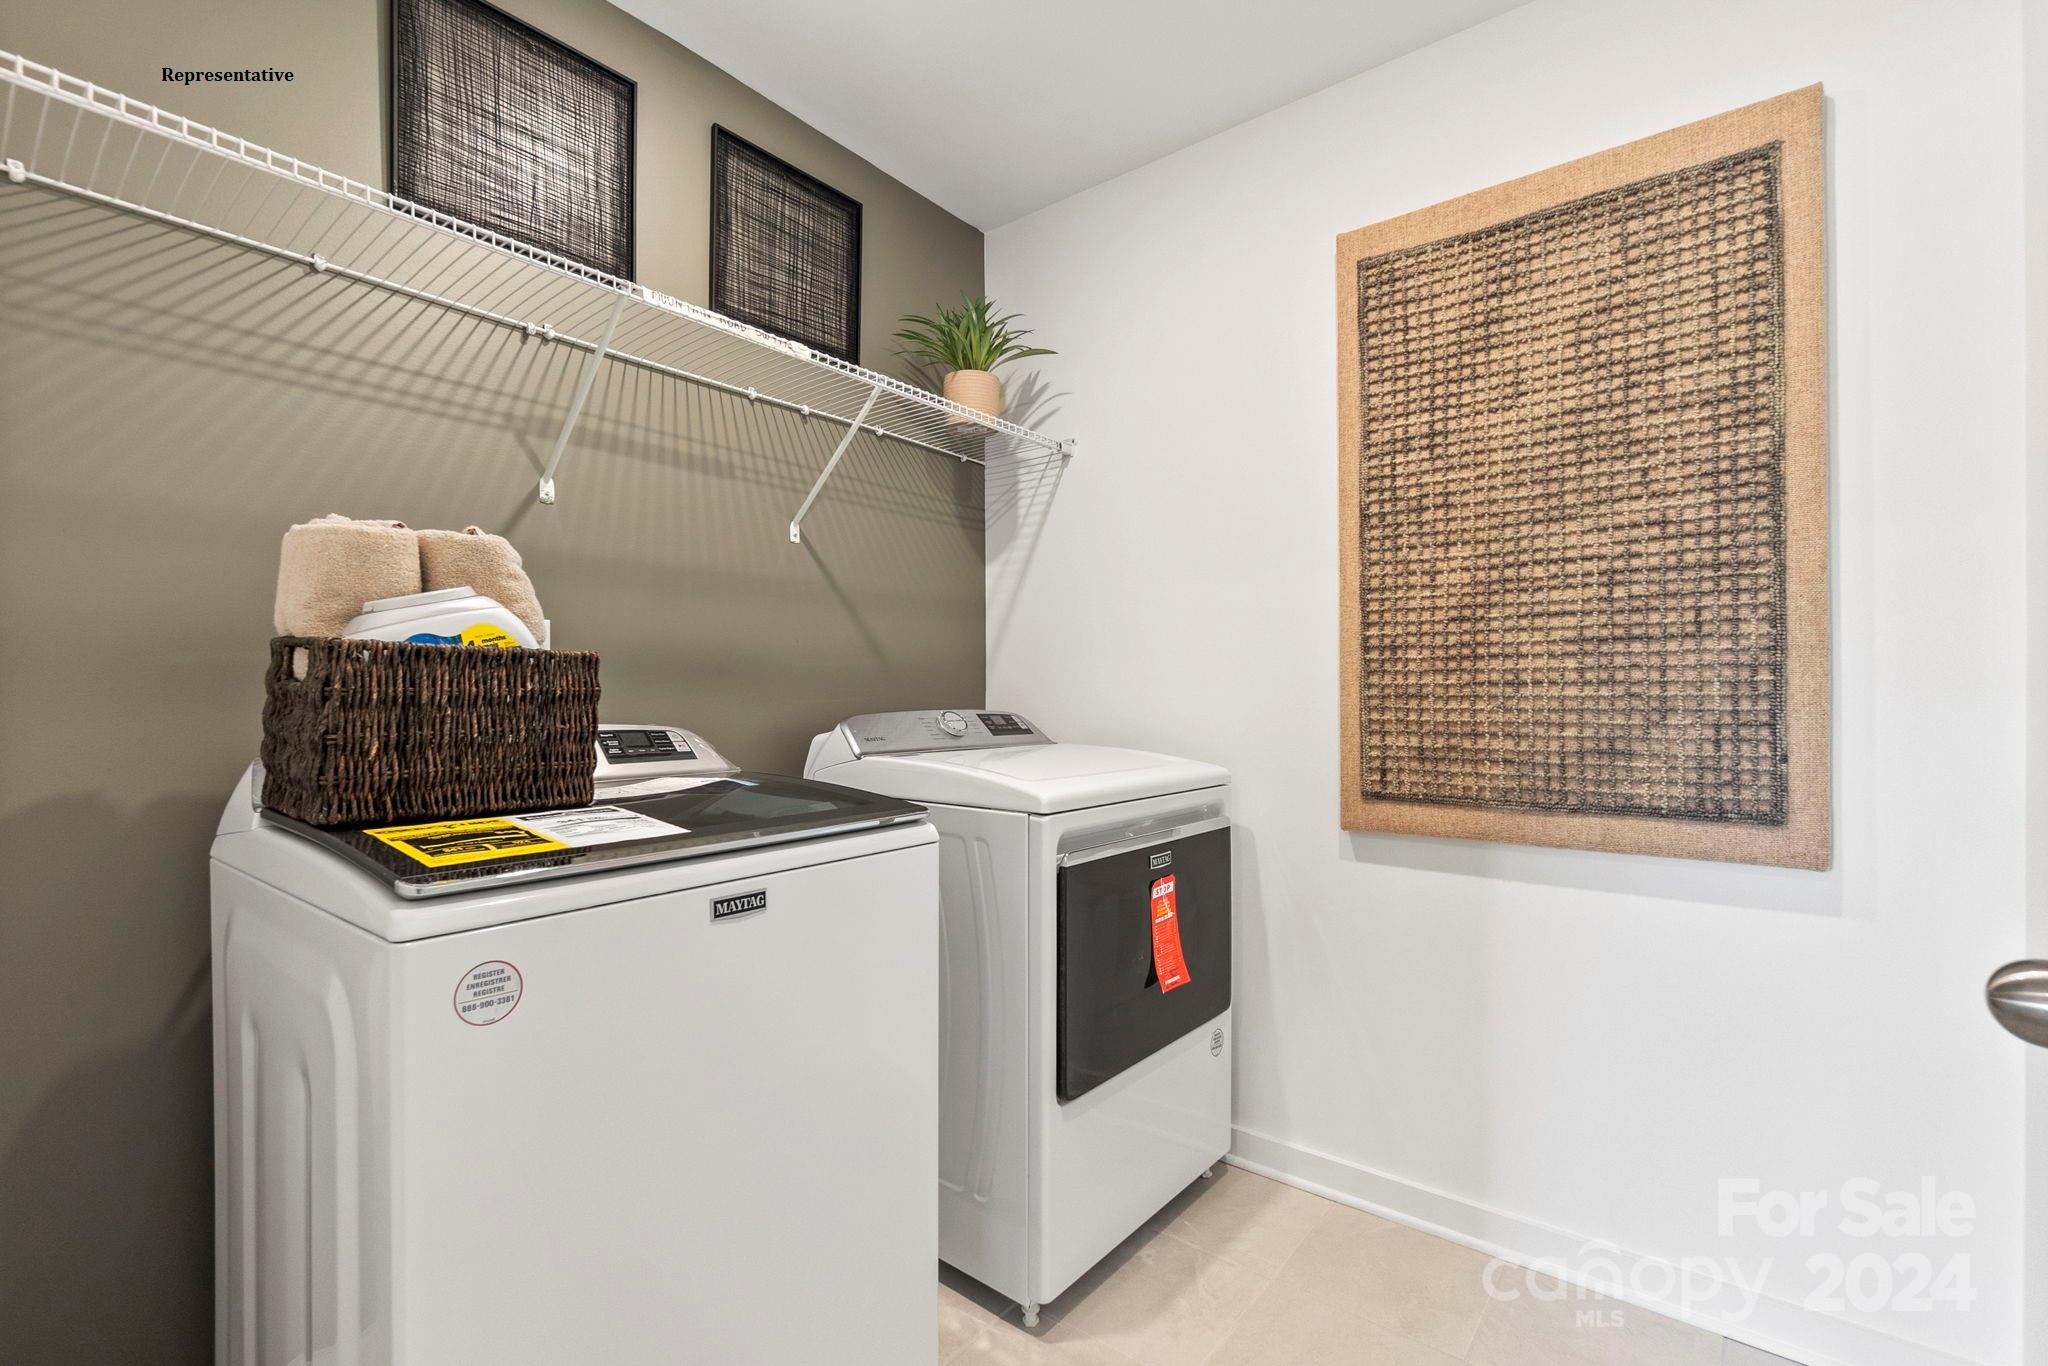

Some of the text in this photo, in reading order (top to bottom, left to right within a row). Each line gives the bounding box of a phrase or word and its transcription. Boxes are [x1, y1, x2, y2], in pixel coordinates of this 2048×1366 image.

[1155, 884, 1171, 896] STOP
[715, 894, 765, 915] MAYTAG
[473, 968, 505, 980] REGISTER
[472, 985, 505, 998] REGISTRE
